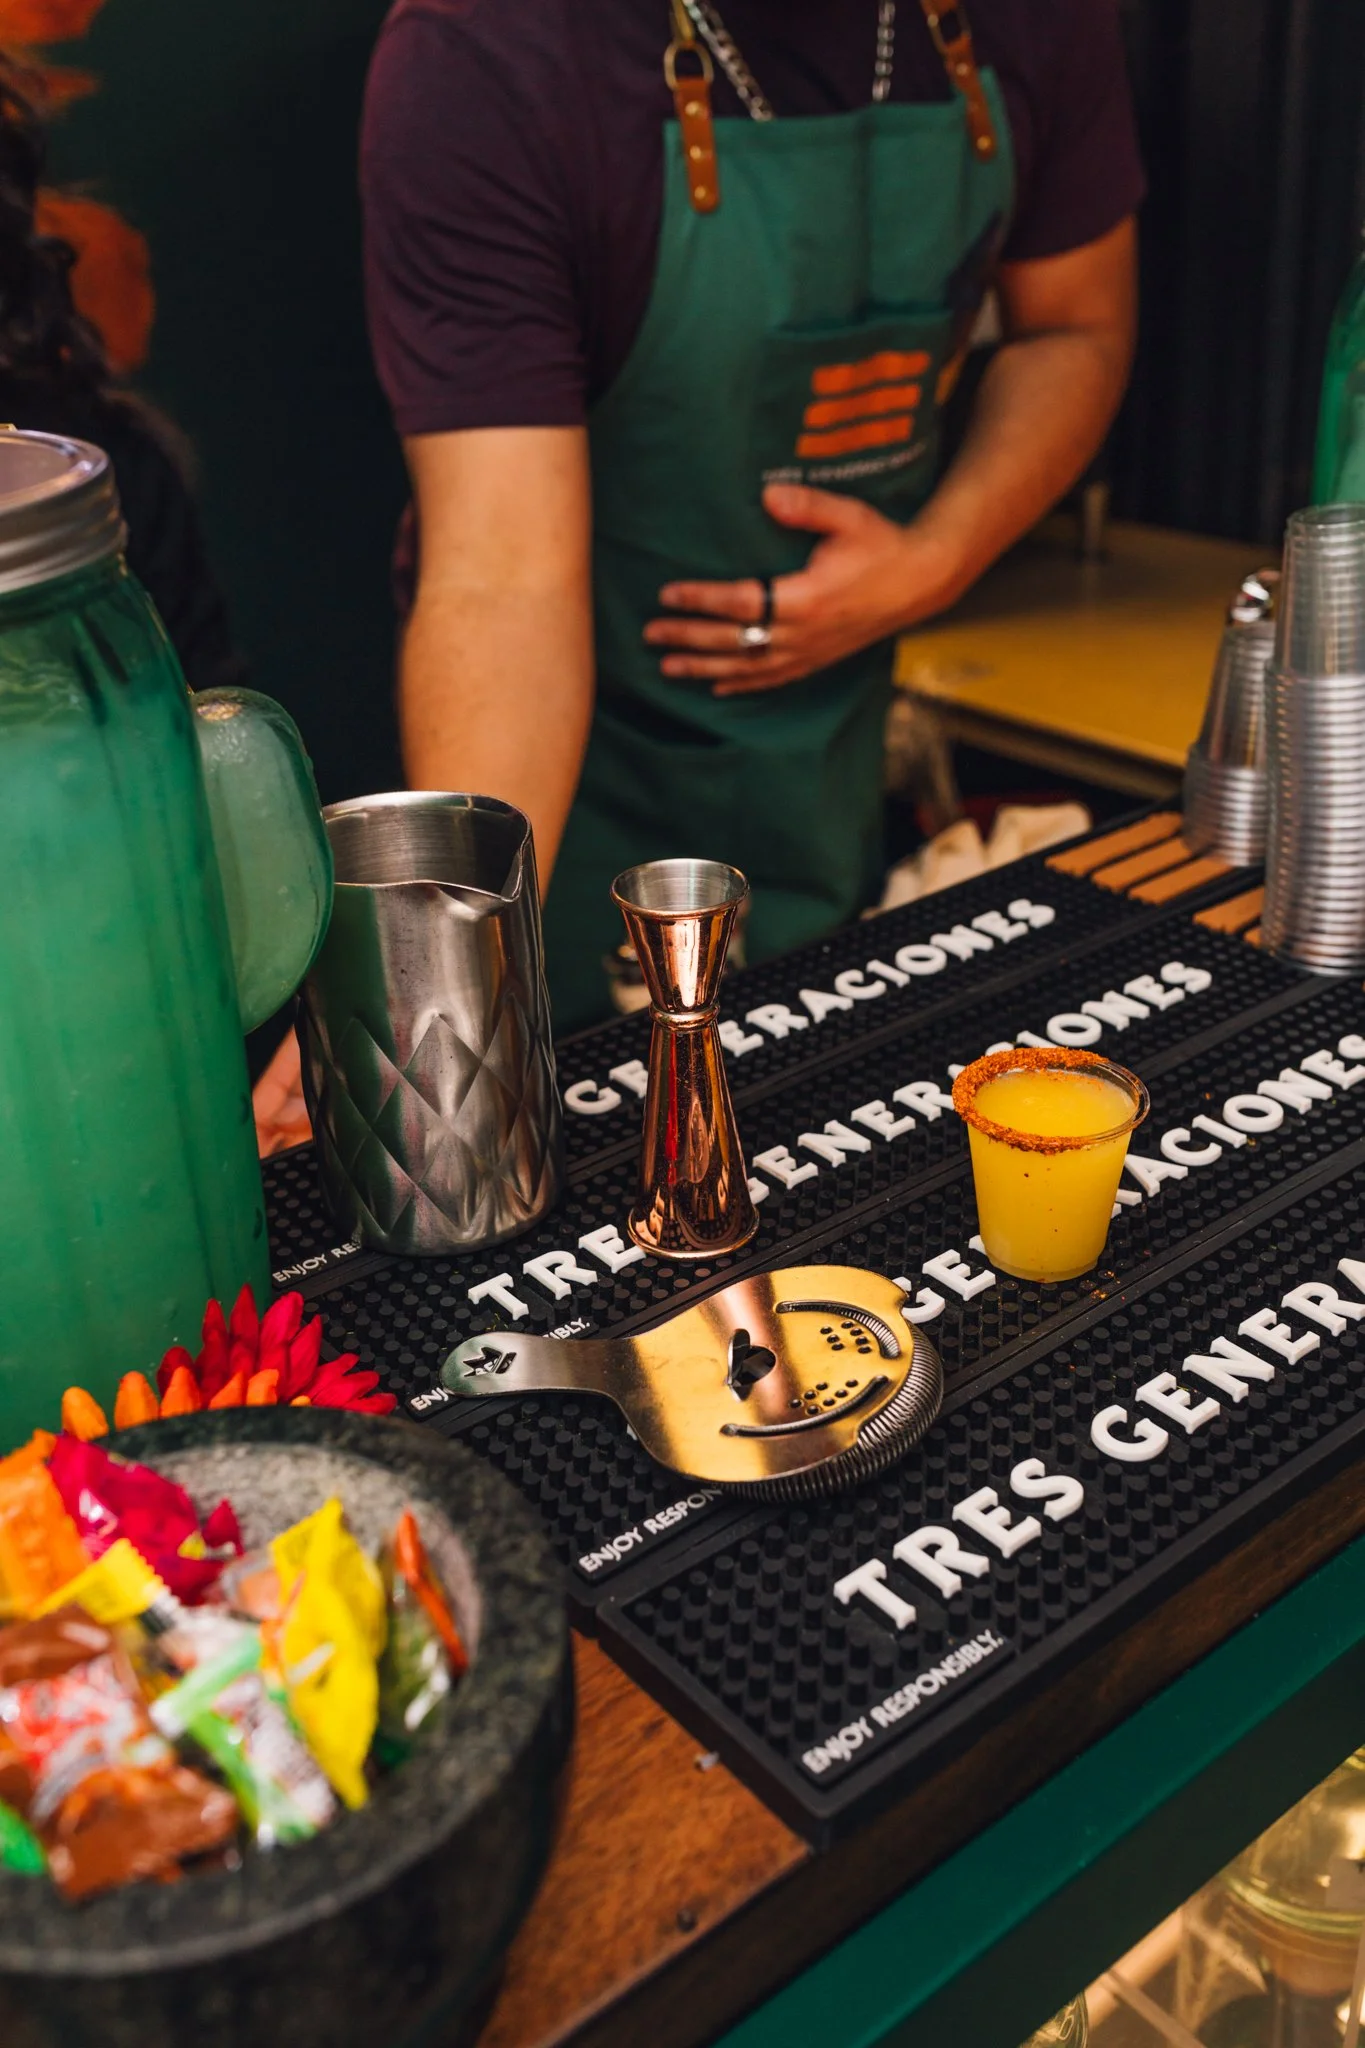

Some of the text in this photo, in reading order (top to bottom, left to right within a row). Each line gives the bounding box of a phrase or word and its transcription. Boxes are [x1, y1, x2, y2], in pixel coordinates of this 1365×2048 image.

[563, 897, 1056, 1115] GEERACIONES
[467, 960, 1213, 1321] TRE ENERIONES
[272, 1253, 328, 1282] ENJOY
[410, 1387, 450, 1411] ENJ
[578, 1526, 643, 1573] ENJOY
[833, 1457, 1085, 1630] TRES
[802, 1629, 1004, 1774] ENJOY RESPONSIBLY.
